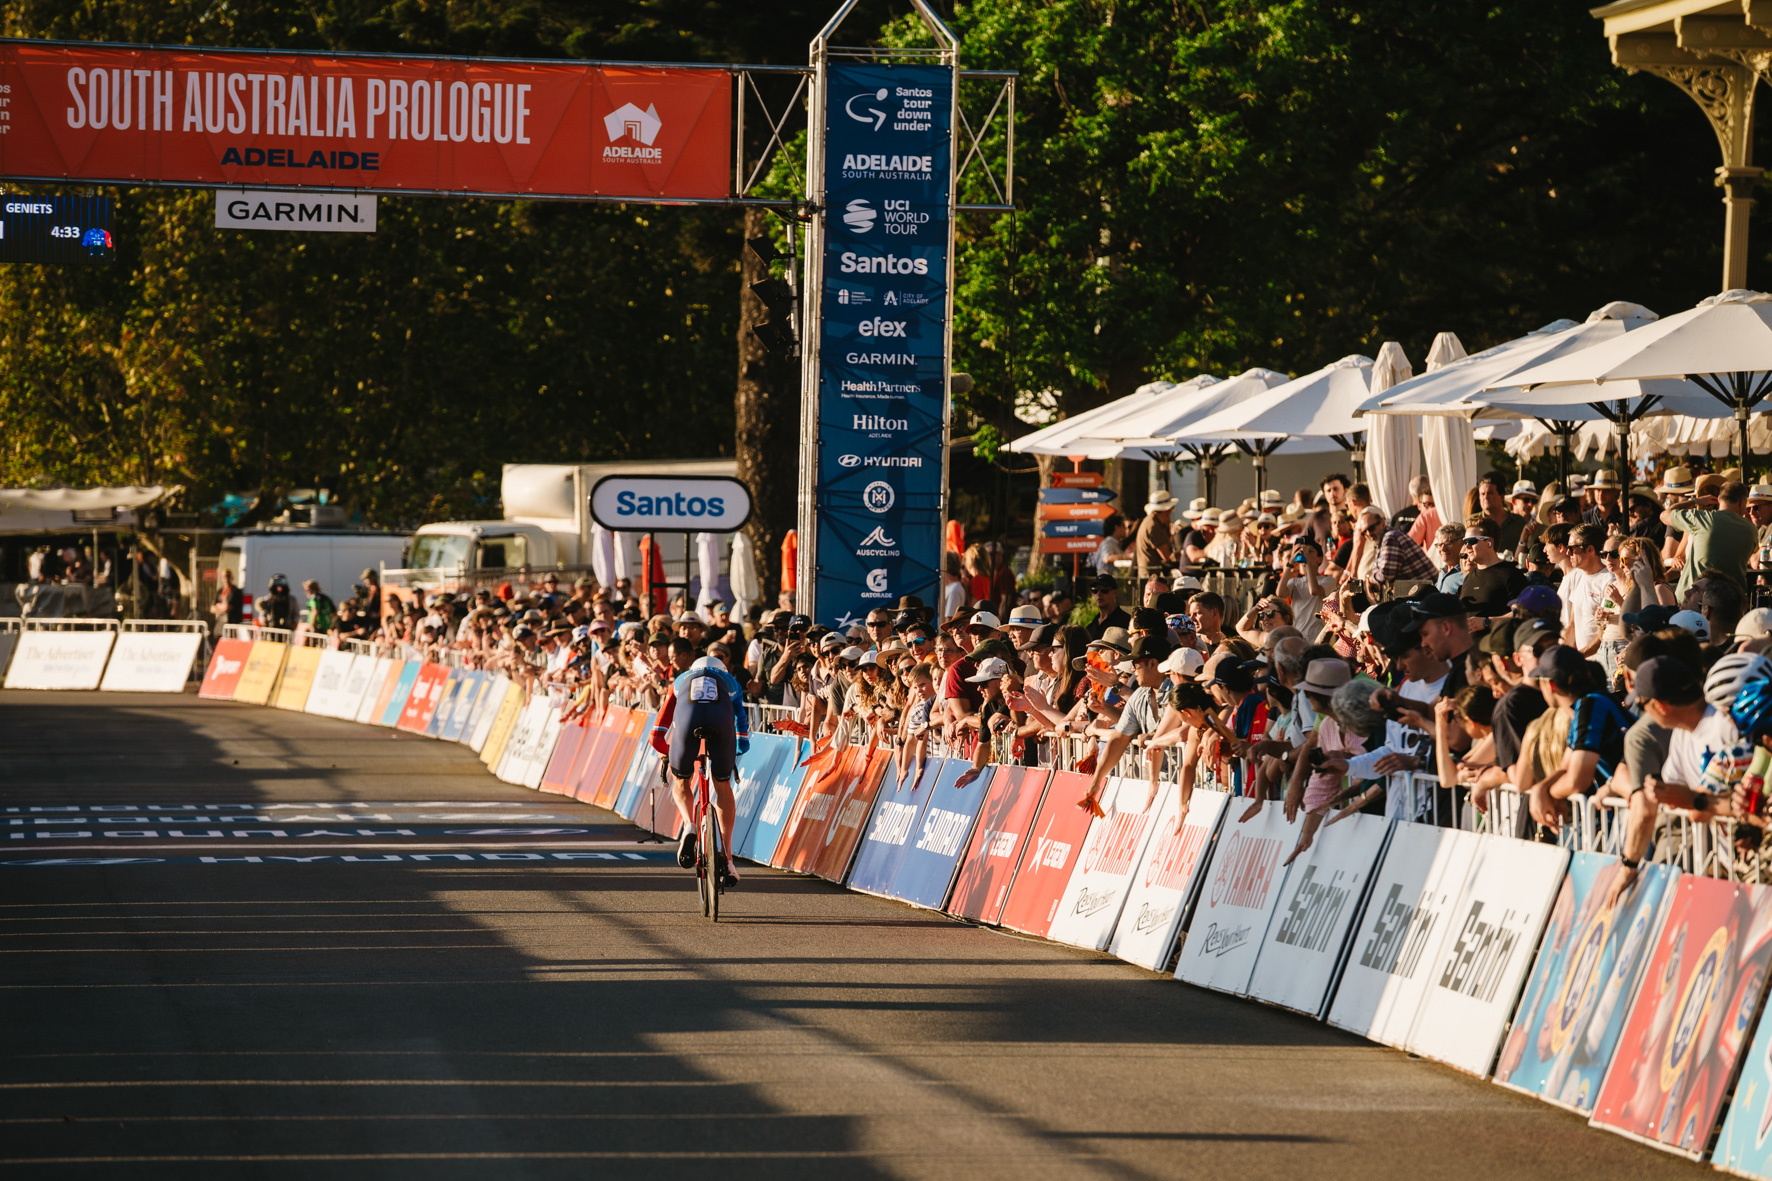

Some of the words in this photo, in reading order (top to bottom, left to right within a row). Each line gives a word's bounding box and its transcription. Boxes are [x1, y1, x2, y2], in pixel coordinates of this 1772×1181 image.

[896, 87, 932, 98] Santos
[67, 67, 173, 132] SOUTH
[183, 72, 356, 138] AUSTRALIA
[366, 78, 532, 144] PROLOGUE
[904, 99, 932, 108] tour
[897, 109, 932, 119] down
[894, 121, 932, 131] under
[221, 148, 379, 171] ADELAIDE
[603, 146, 662, 159] ADELAIDE
[842, 154, 932, 172] ADELAIDE
[879, 172, 932, 180] AUSTRALIA
[6, 202, 53, 215] GENIETS
[884, 200, 909, 210] UCI
[884, 212, 929, 223] WORLD
[51, 226, 80, 238] 4:33
[884, 224, 917, 234] TOUR
[840, 252, 928, 274] Santos
[858, 317, 906, 337] efex
[841, 381, 876, 391] Health
[878, 381, 921, 393] Partners
[853, 415, 908, 430] Hilton
[864, 456, 922, 468] HYUNDAI
[616, 490, 725, 517] Santos
[868, 801, 918, 846] SHIMANO
[915, 808, 971, 857] SHIMANO
[1094, 811, 1150, 876] YAMAHA
[199, 854, 648, 864] HYUNDAI
[1042, 839, 1072, 870] LEGEND
[1155, 823, 1209, 892] YAMAHA
[1223, 836, 1284, 910] YAMAHA
[1276, 865, 1358, 952] Santini
[1360, 883, 1447, 979] Santini
[1439, 900, 1530, 1003] Santini
